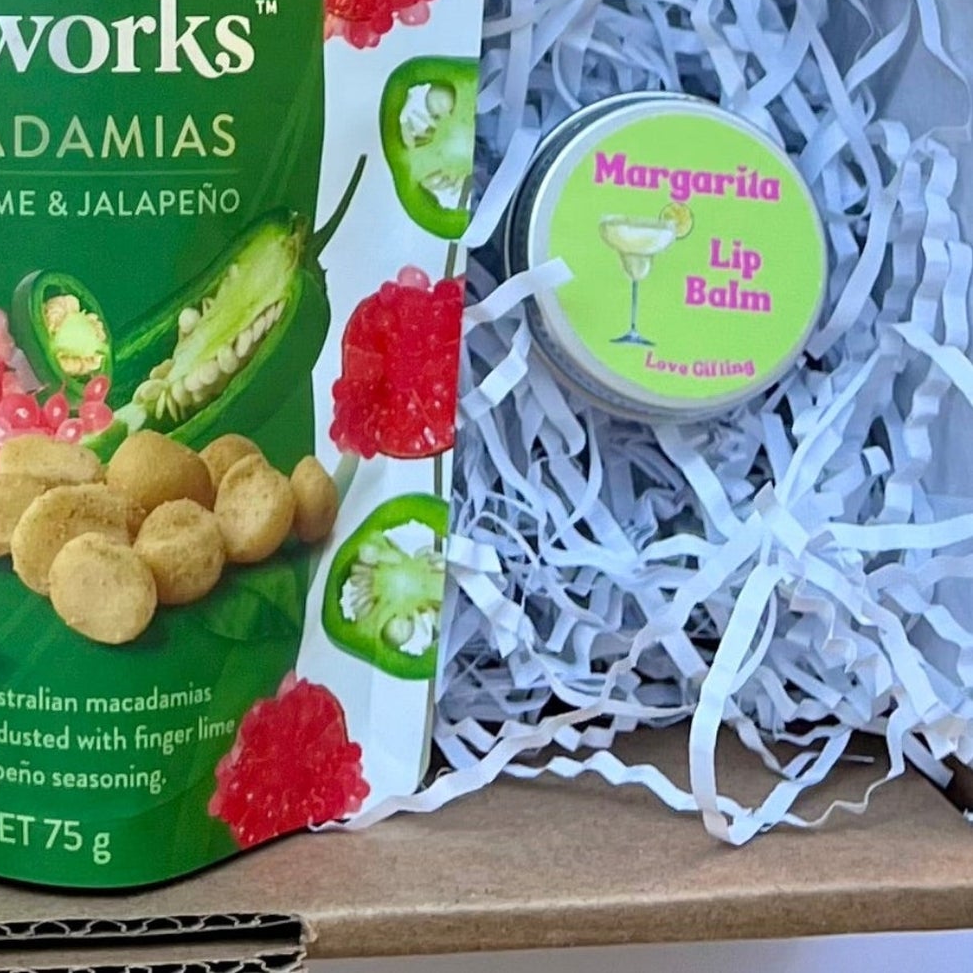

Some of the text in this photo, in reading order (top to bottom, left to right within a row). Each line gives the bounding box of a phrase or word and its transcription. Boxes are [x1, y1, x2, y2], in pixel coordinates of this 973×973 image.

[594, 151, 781, 202] Margarita
[47, 190, 69, 216] &
[77, 182, 240, 216] JALAPEÑO
[709, 238, 762, 278] Lip
[685, 276, 772, 312] Balm
[645, 350, 688, 376] Love
[85, 681, 212, 714] macadamias
[77, 727, 126, 752] with
[134, 724, 194, 756] finger
[198, 715, 235, 741] lime
[52, 764, 167, 795] seasoning.
[43, 819, 84, 852] 75
[92, 833, 112, 865] g
